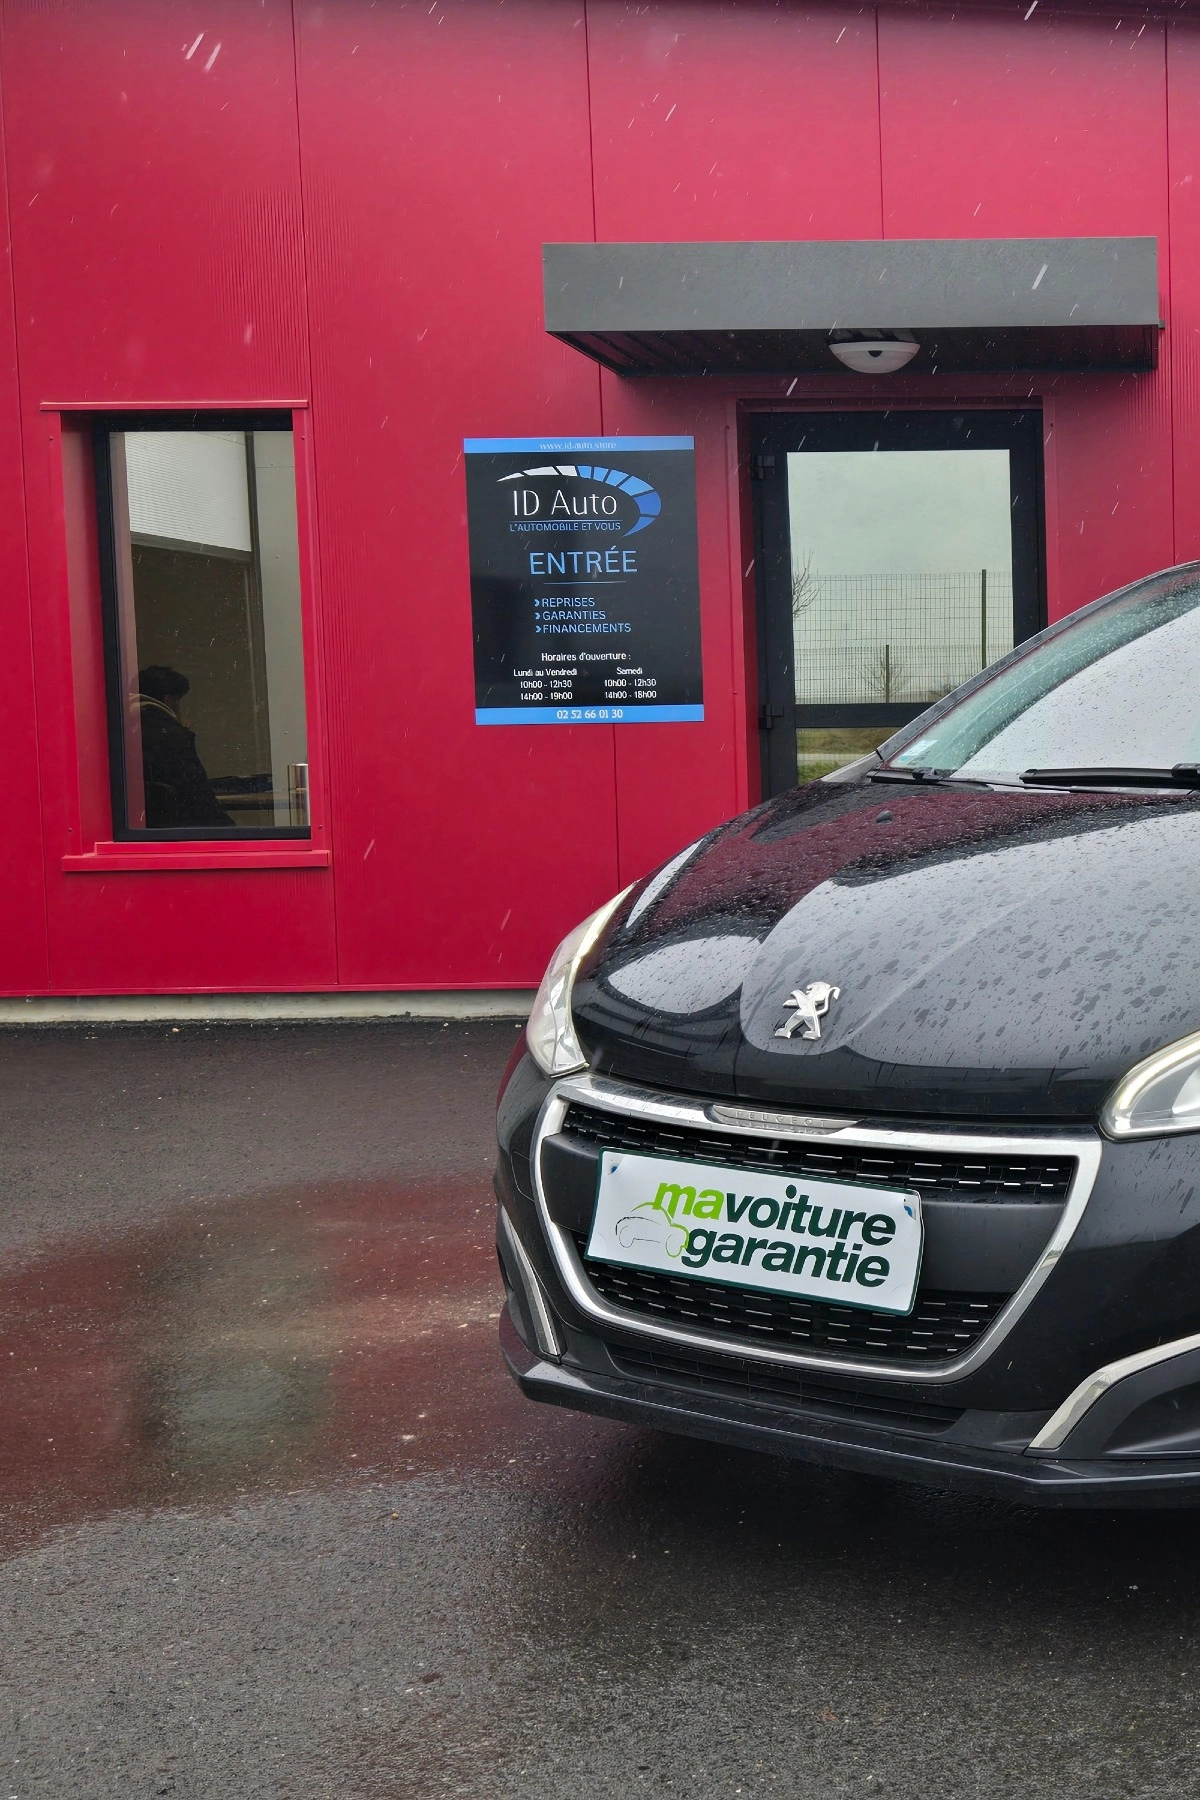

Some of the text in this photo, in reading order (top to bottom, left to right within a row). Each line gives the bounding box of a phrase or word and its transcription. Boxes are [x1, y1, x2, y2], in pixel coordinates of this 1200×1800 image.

[513, 489, 618, 516] ID Auto
[509, 522, 621, 532] L'AUTOMOBILE ET VOUS
[529, 545, 638, 575] ENTRÉE
[541, 597, 595, 608] REPRISES
[542, 610, 606, 621] GARANTIES
[543, 622, 632, 634] FINANCEMENTS
[541, 652, 577, 662] Horaires
[578, 651, 627, 662] d'ouverture
[513, 668, 533, 677] Lundi
[545, 668, 578, 676] Vendredi
[616, 666, 643, 675] Samedi
[520, 680, 542, 689] 10h00
[550, 679, 573, 688] 12h30
[604, 679, 627, 688] 10h00
[634, 678, 657, 687] 12h30
[520, 692, 543, 701] 14h00
[550, 691, 573, 700] 19h00
[604, 691, 627, 699] 14h00
[634, 690, 657, 699] 18h00
[556, 709, 623, 719] 02 52 66 01 30
[735, 1110, 826, 1128] PEUGEOT
[652, 1181, 896, 1246] mavoiture
[681, 1227, 890, 1287] garantie
